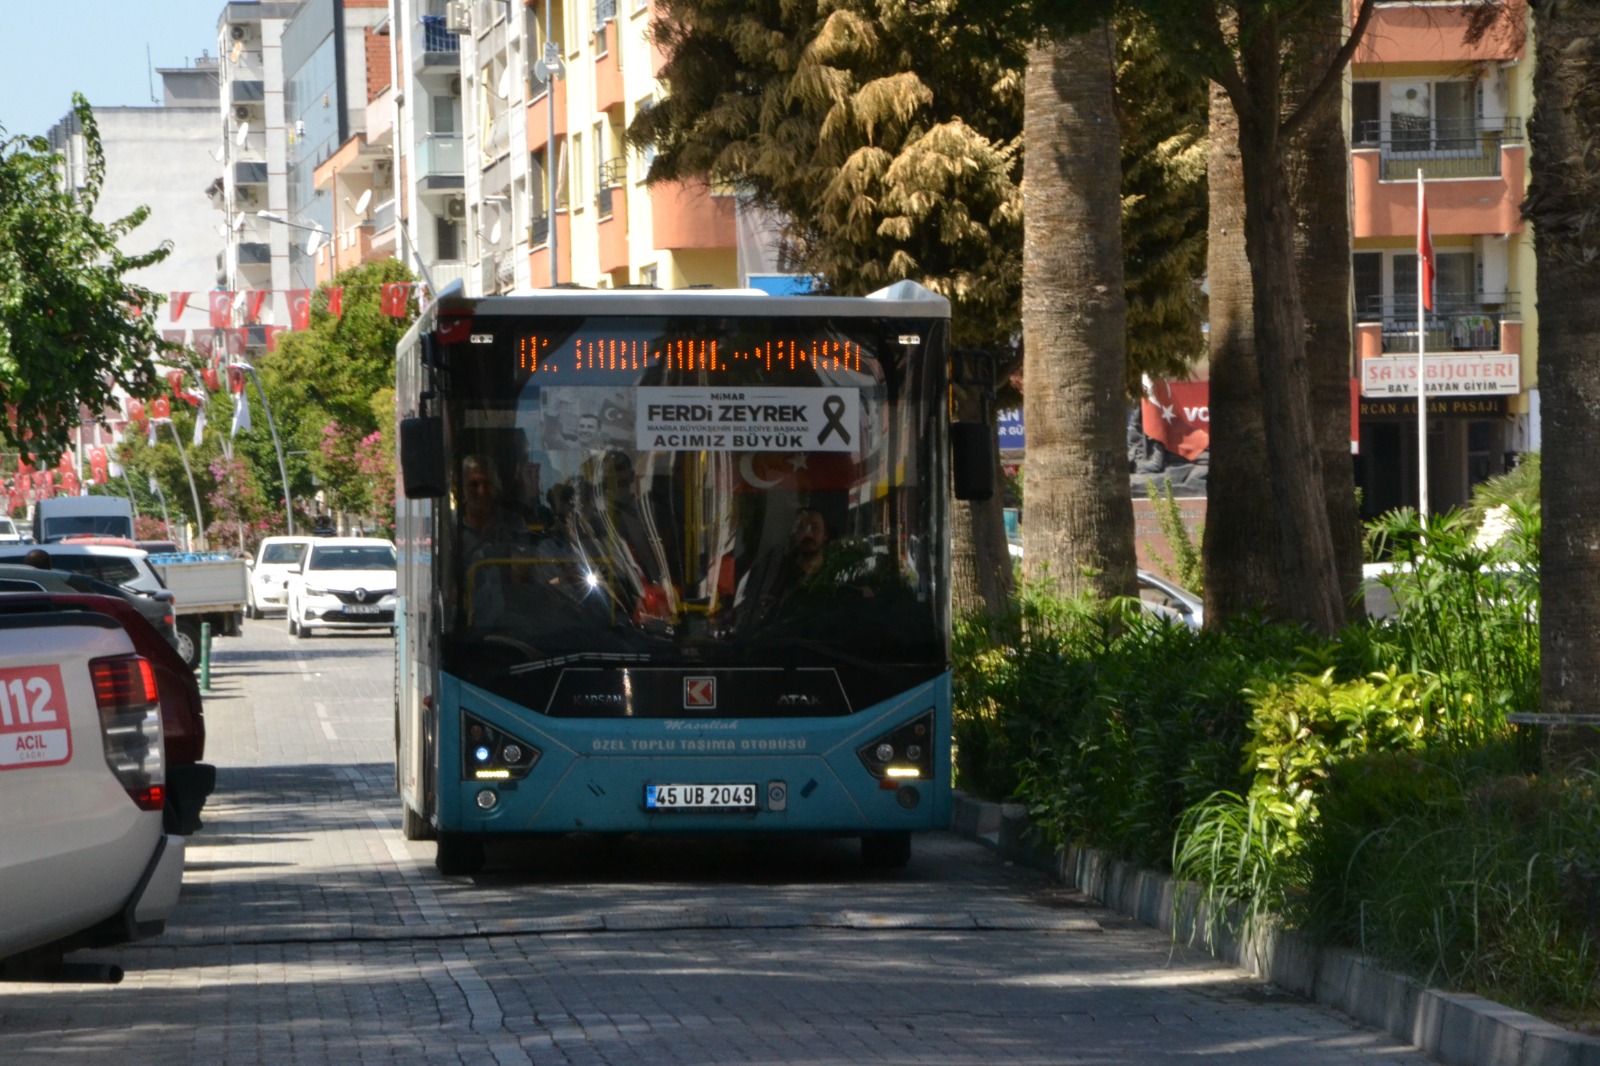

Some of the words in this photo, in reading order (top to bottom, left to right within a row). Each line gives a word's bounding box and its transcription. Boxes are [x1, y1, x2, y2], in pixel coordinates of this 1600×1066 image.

[1426, 360, 1514, 381] BİJUTERİ
[1388, 384, 1409, 393] BAY
[1464, 380, 1497, 391] GİYİM
[719, 405, 808, 422] ZEYREK
[653, 434, 725, 447] ACIMIZ
[733, 432, 803, 447] BÜYÜK
[592, 737, 625, 750] ÖZEL
[631, 739, 675, 751] TOPLU
[656, 787, 677, 805] 45
[683, 786, 704, 805] UB
[710, 786, 753, 805] 2049
